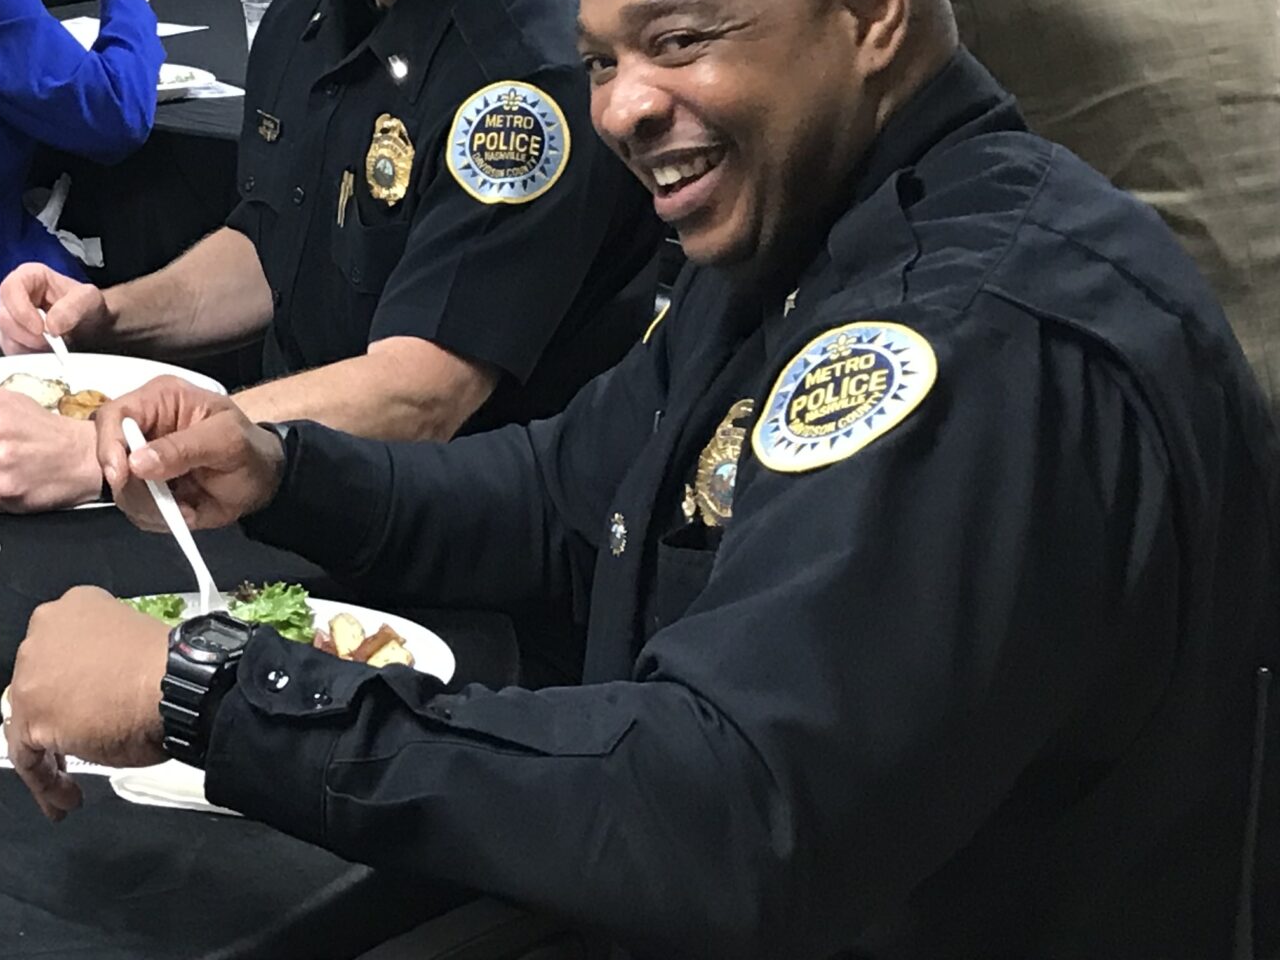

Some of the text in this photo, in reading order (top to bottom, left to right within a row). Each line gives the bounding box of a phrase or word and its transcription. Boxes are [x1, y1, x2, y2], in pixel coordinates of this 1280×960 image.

[484, 114, 535, 130] METRO
[472, 131, 542, 157] POLICE
[484, 151, 527, 162] NASHVILLE
[804, 352, 876, 389] METRO
[789, 368, 890, 421] POLICE
[804, 393, 866, 424] NASHVILLE
